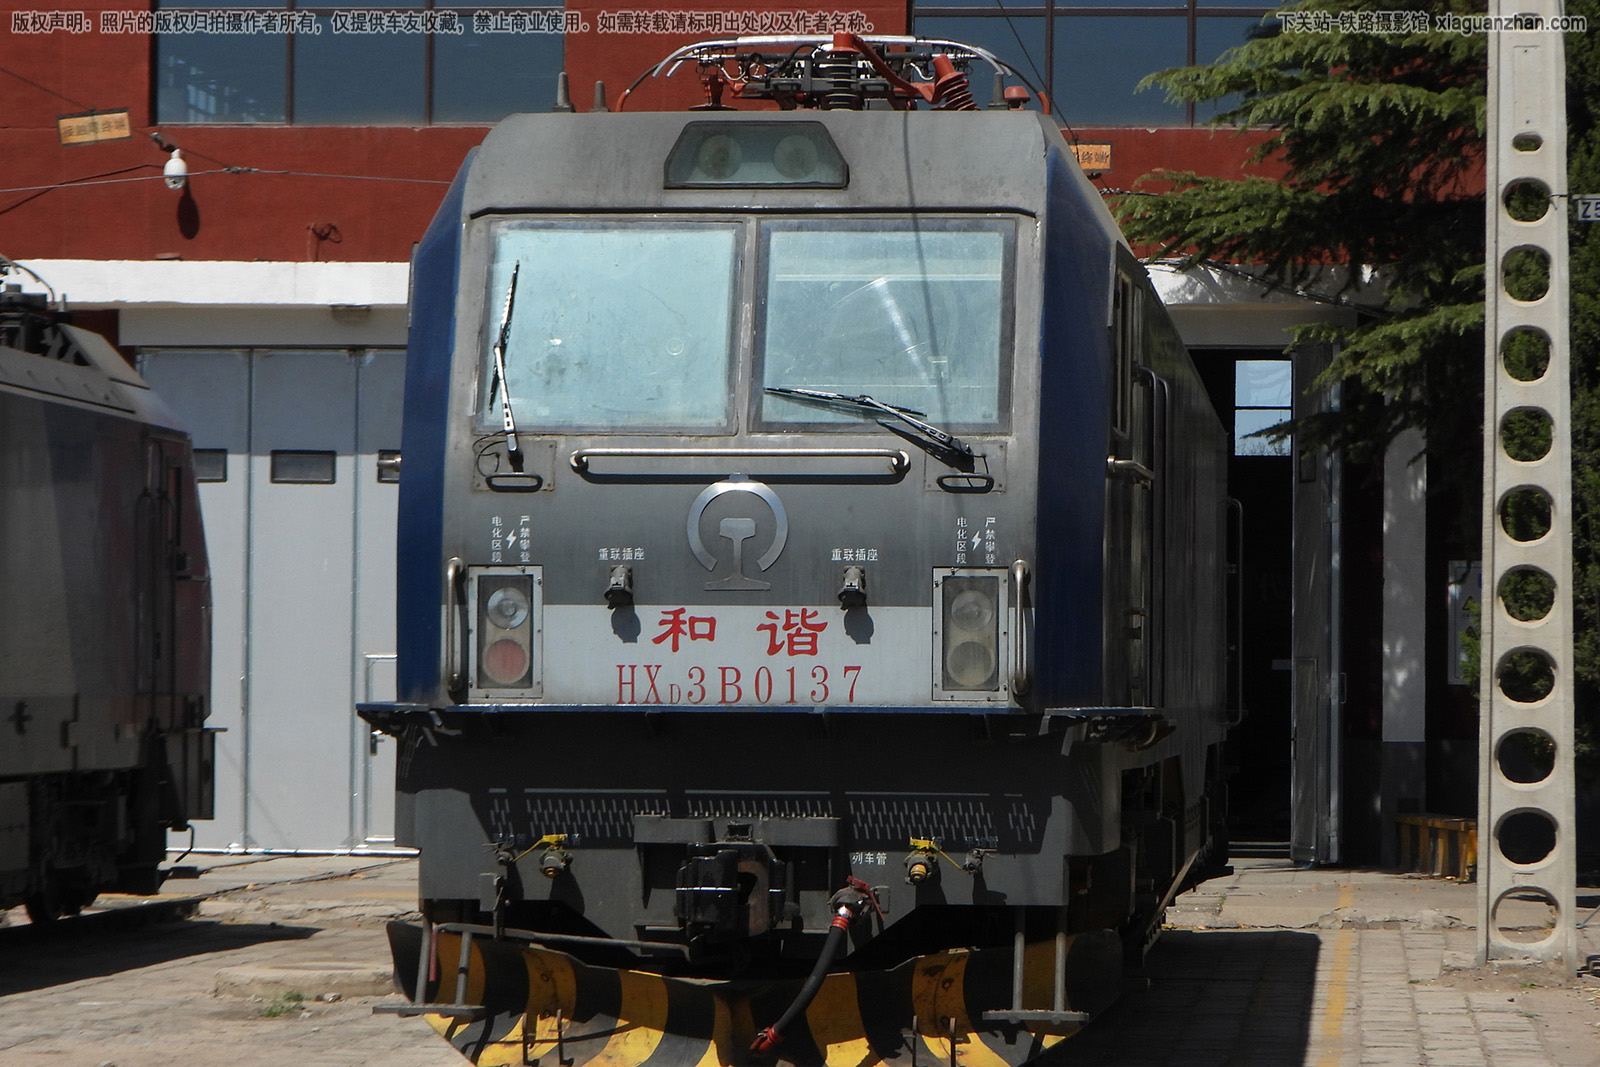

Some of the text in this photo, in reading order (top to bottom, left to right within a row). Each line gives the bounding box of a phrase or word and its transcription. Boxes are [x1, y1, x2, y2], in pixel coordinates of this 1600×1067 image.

[491, 515, 503, 563] 电化区段
[519, 515, 531, 563] 严禁攀登
[598, 547, 646, 561] 重联插座
[831, 548, 879, 562] 重联插座
[956, 516, 968, 564] 电化区段
[985, 516, 996, 564] 严禁攀登
[651, 607, 828, 657] 和谐
[851, 851, 888, 866] 列车管
